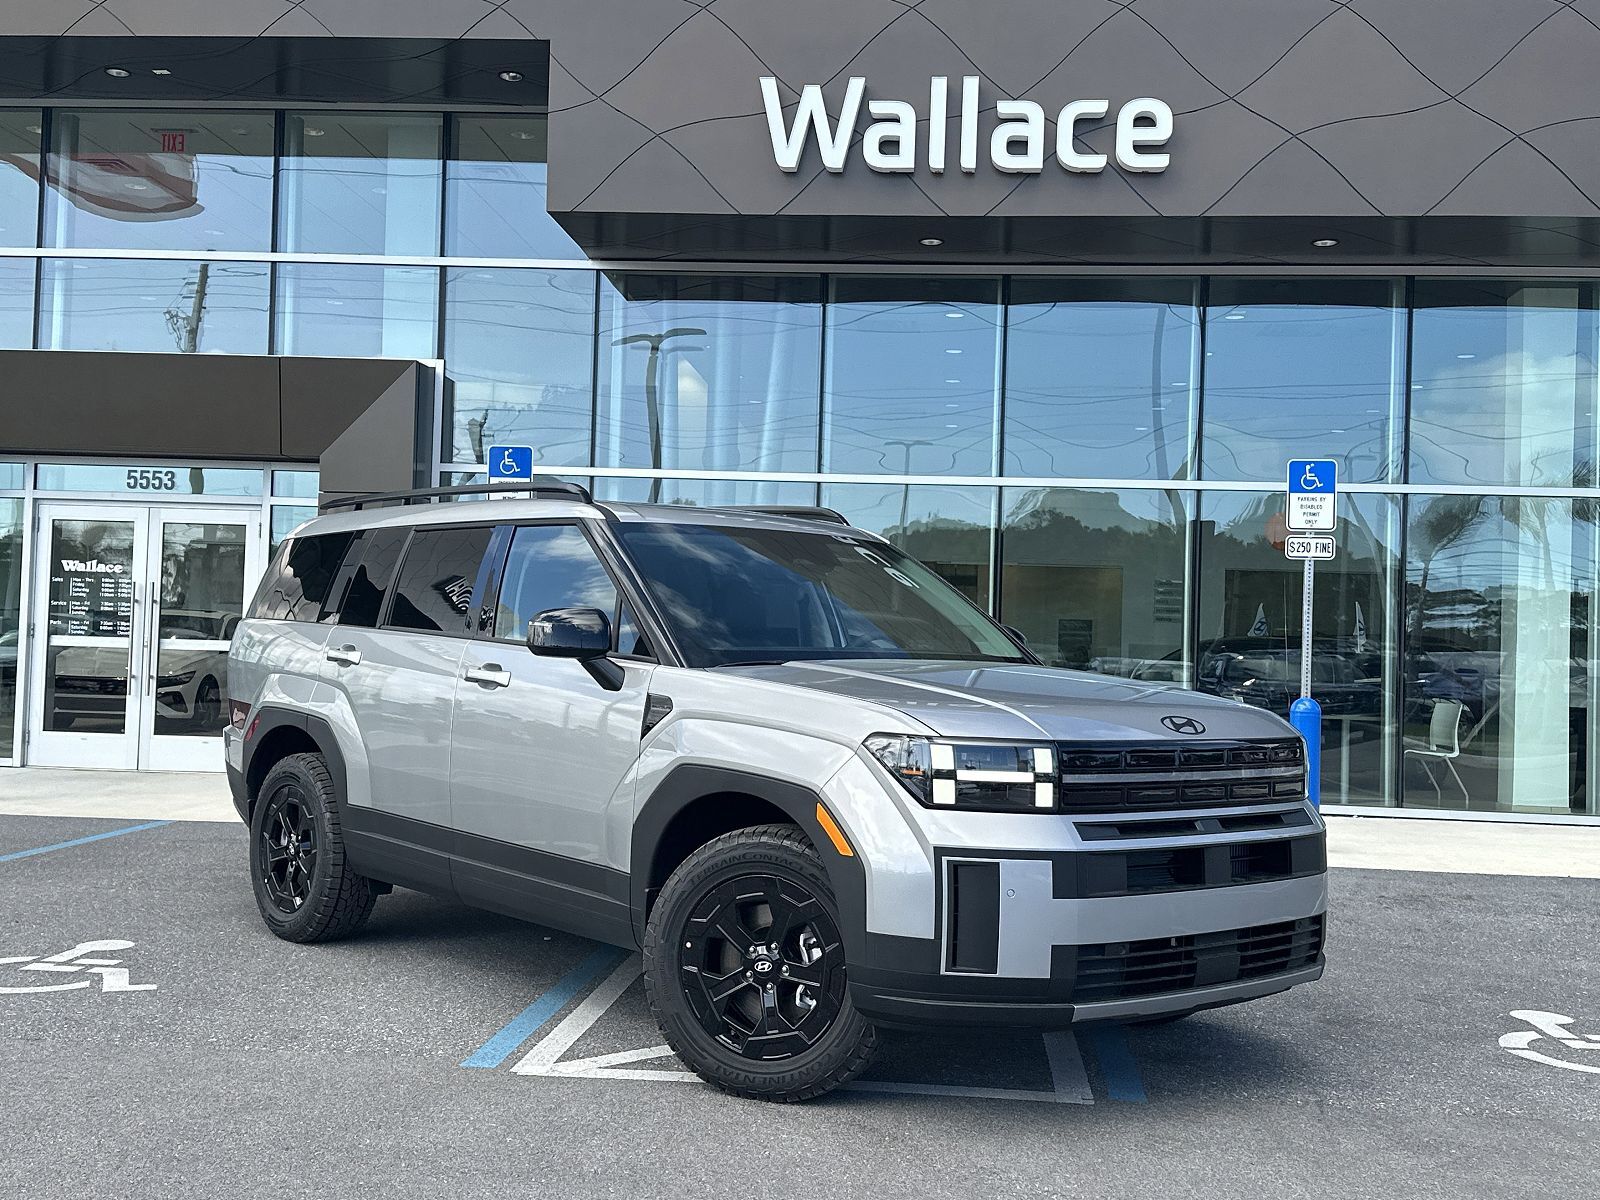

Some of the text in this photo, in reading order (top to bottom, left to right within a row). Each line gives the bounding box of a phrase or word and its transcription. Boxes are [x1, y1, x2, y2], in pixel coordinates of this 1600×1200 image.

[759, 75, 1174, 174] Wallace
[126, 469, 176, 491] 5553
[1289, 541, 1331, 554] $250 FINE
[61, 559, 124, 574] Wallace
